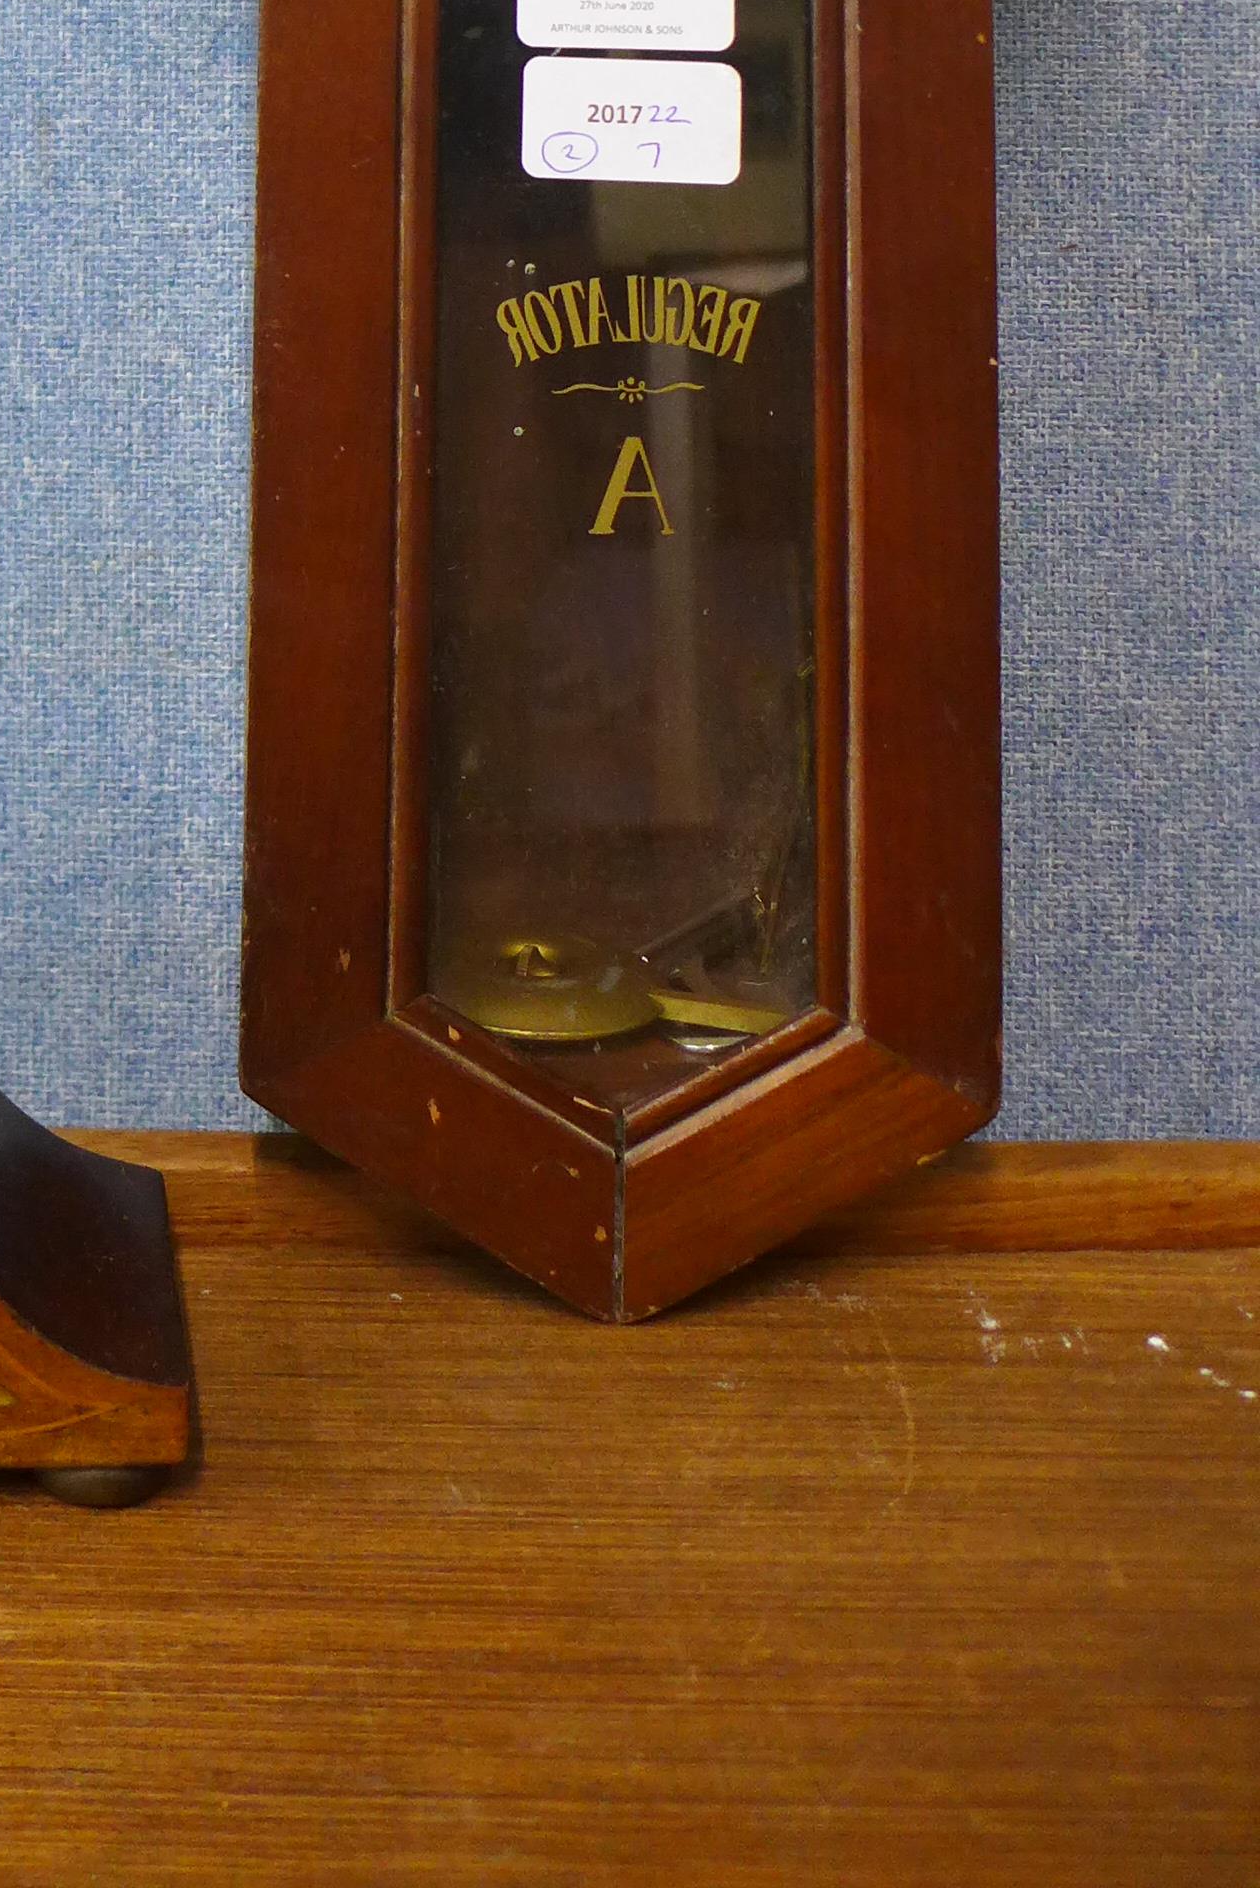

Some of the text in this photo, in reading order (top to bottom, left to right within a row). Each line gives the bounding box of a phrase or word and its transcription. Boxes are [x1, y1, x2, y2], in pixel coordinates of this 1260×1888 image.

[580, 1, 654, 10] 27th June 2020
[550, 24, 683, 35] ARTHUR JOHNSON & SONS
